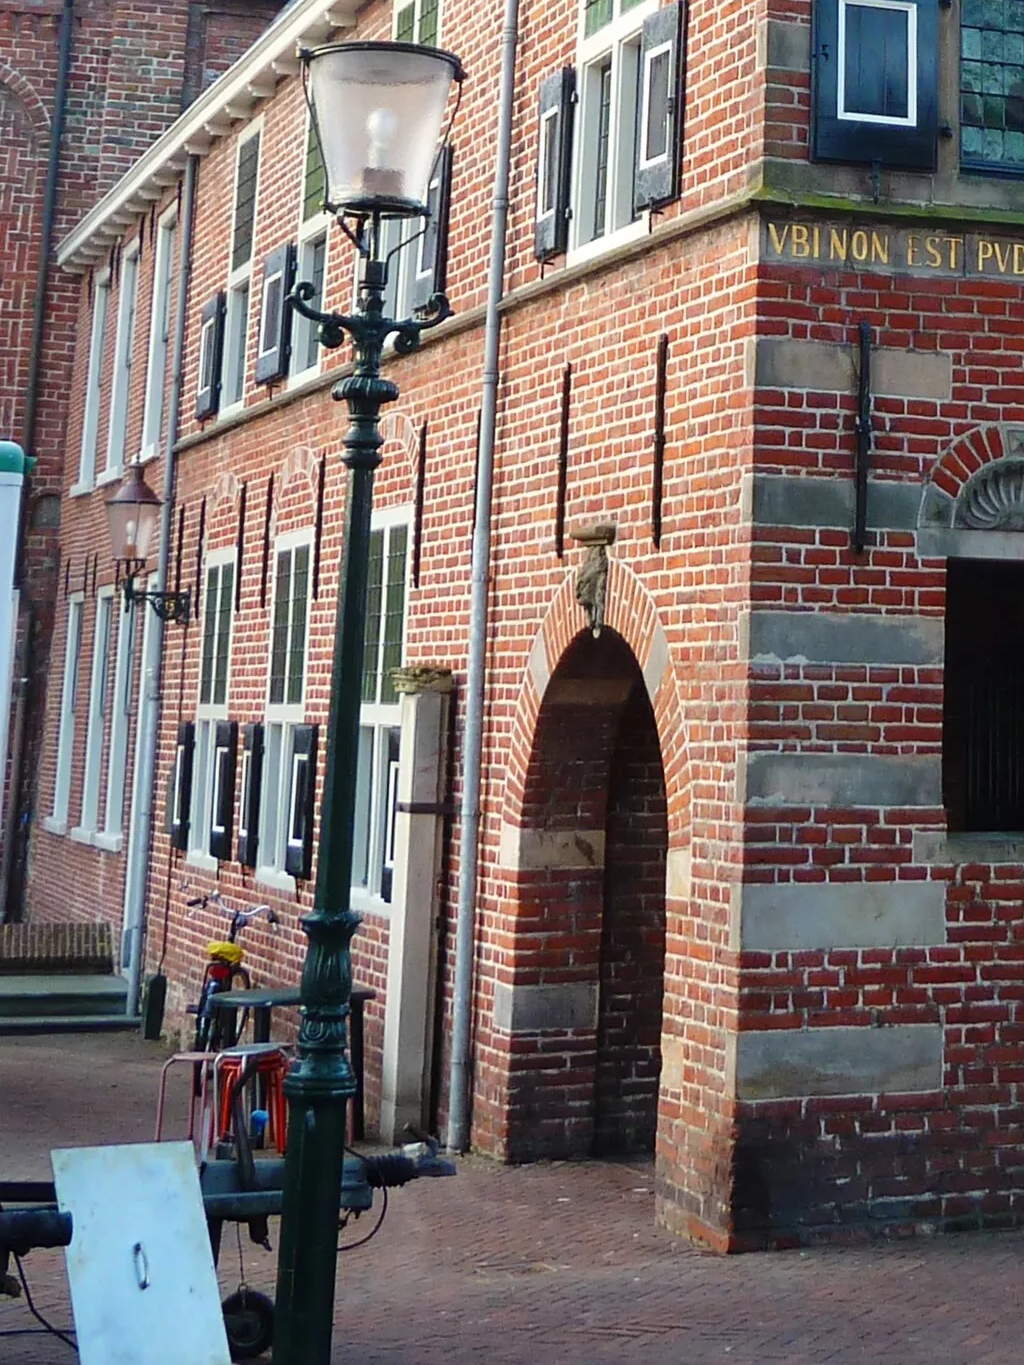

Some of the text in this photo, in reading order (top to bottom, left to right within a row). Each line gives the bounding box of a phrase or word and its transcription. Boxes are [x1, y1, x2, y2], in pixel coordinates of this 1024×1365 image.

[767, 222, 820, 259] VBI
[830, 228, 889, 265] NON
[907, 234, 964, 269] EST
